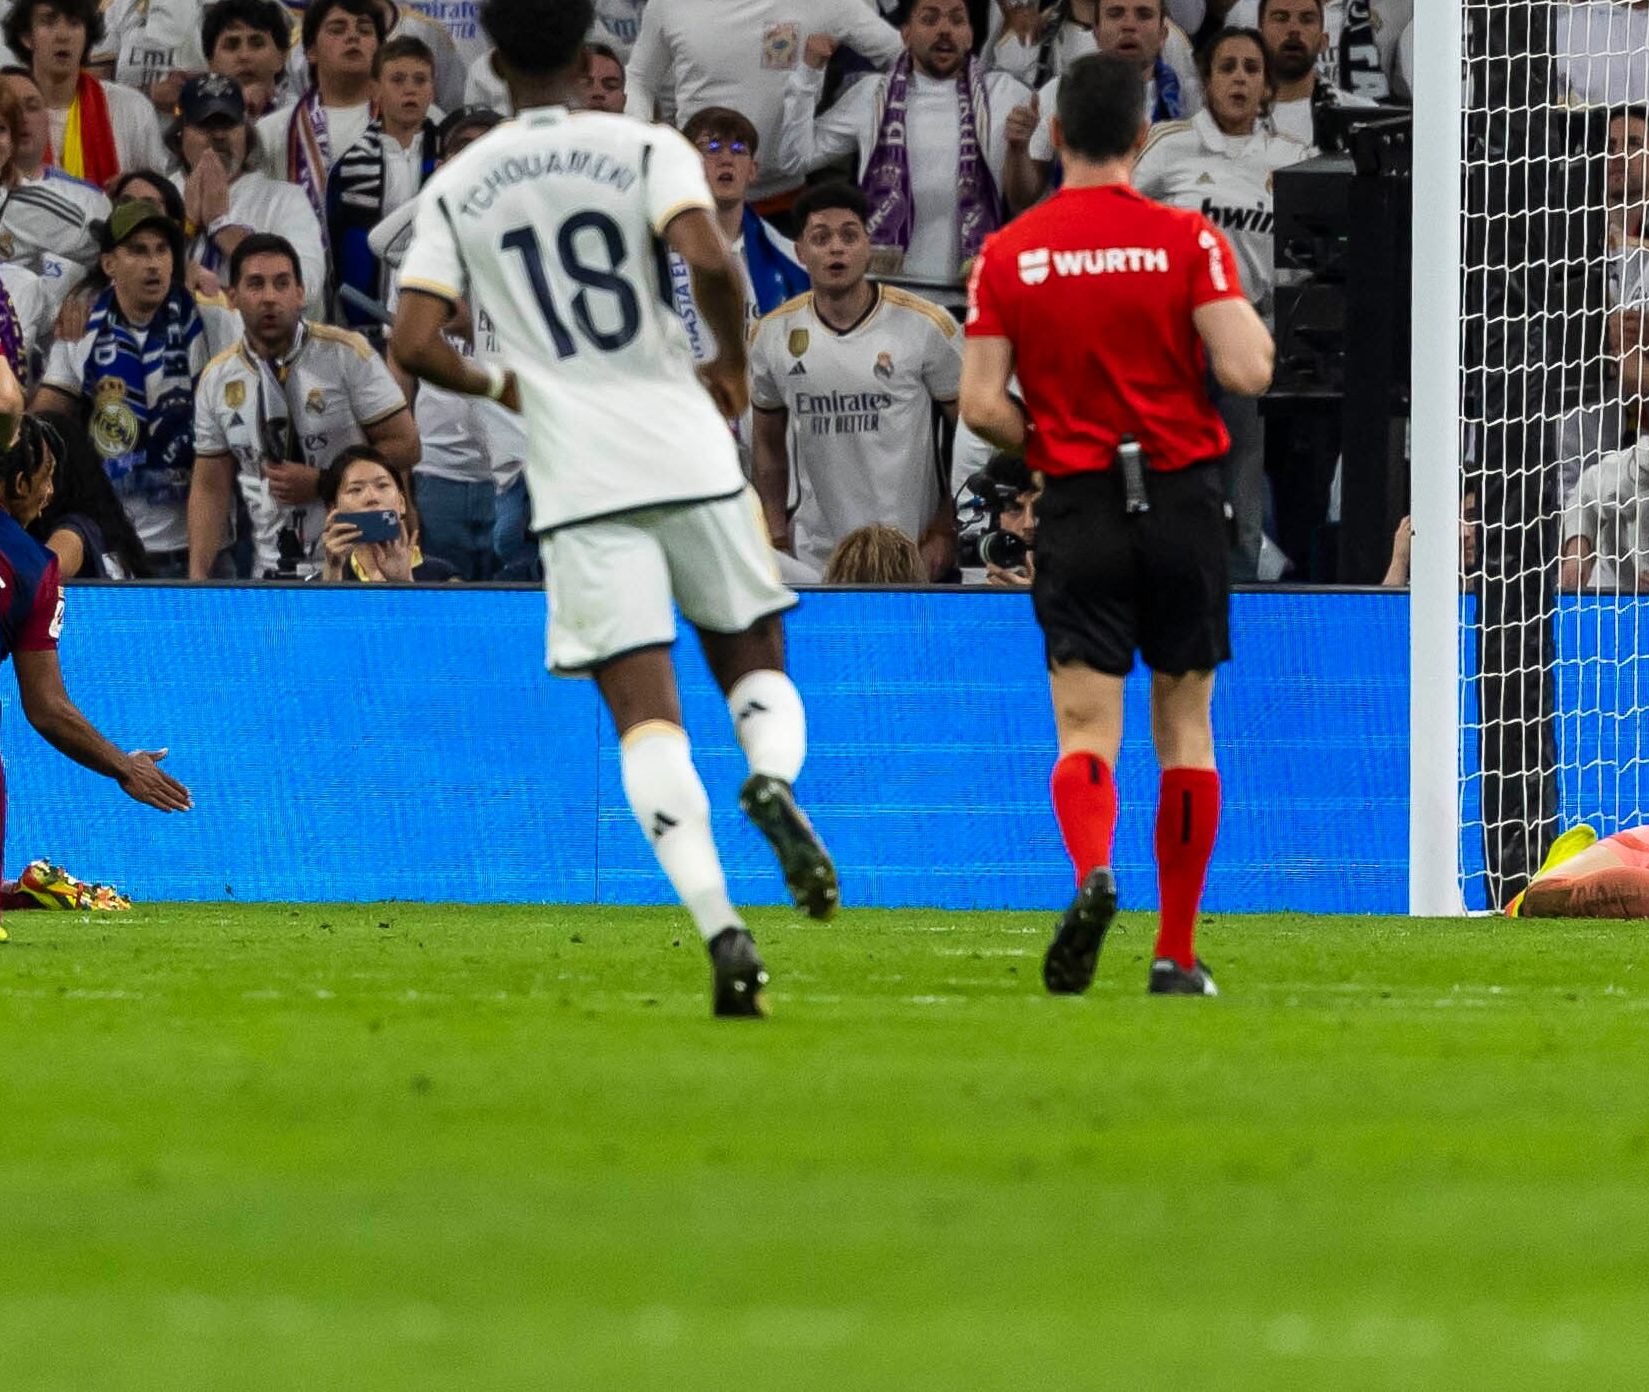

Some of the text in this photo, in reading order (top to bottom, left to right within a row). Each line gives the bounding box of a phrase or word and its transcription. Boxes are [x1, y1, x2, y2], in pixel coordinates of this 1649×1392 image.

[501, 210, 640, 359] 18
[794, 392, 893, 416] Emirates
[810, 414, 881, 436] FLY BETTER
